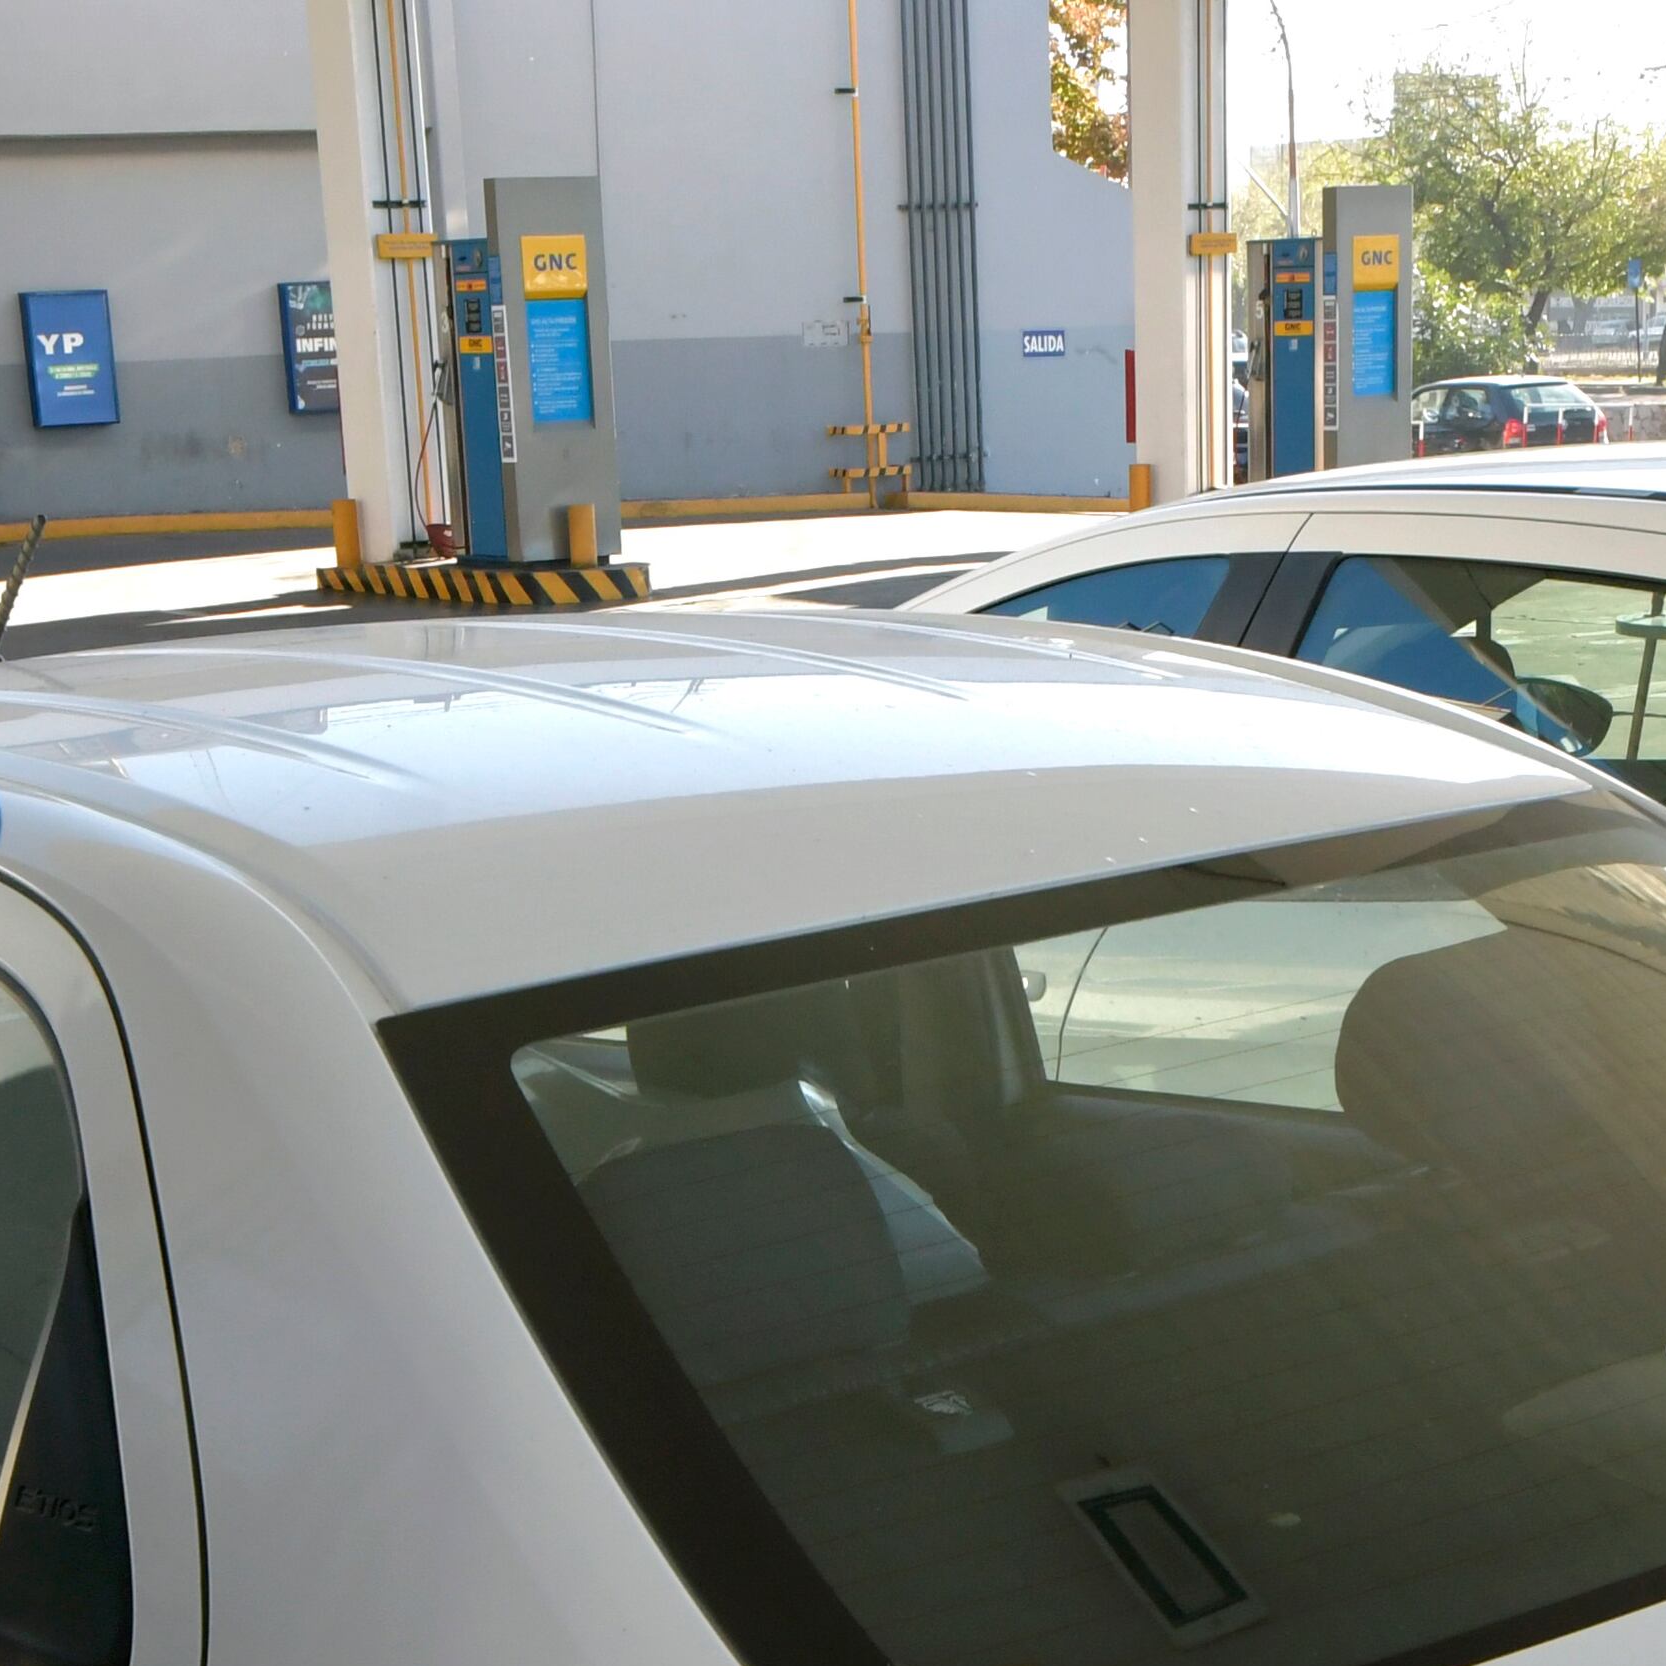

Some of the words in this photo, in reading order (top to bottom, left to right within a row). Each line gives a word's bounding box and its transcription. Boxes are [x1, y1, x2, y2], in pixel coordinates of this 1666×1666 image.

[534, 253, 577, 271] GNC
[1361, 250, 1393, 266] GNC
[1255, 300, 1264, 319] 5
[36, 332, 85, 355] YP
[1024, 334, 1064, 352] SALIDA
